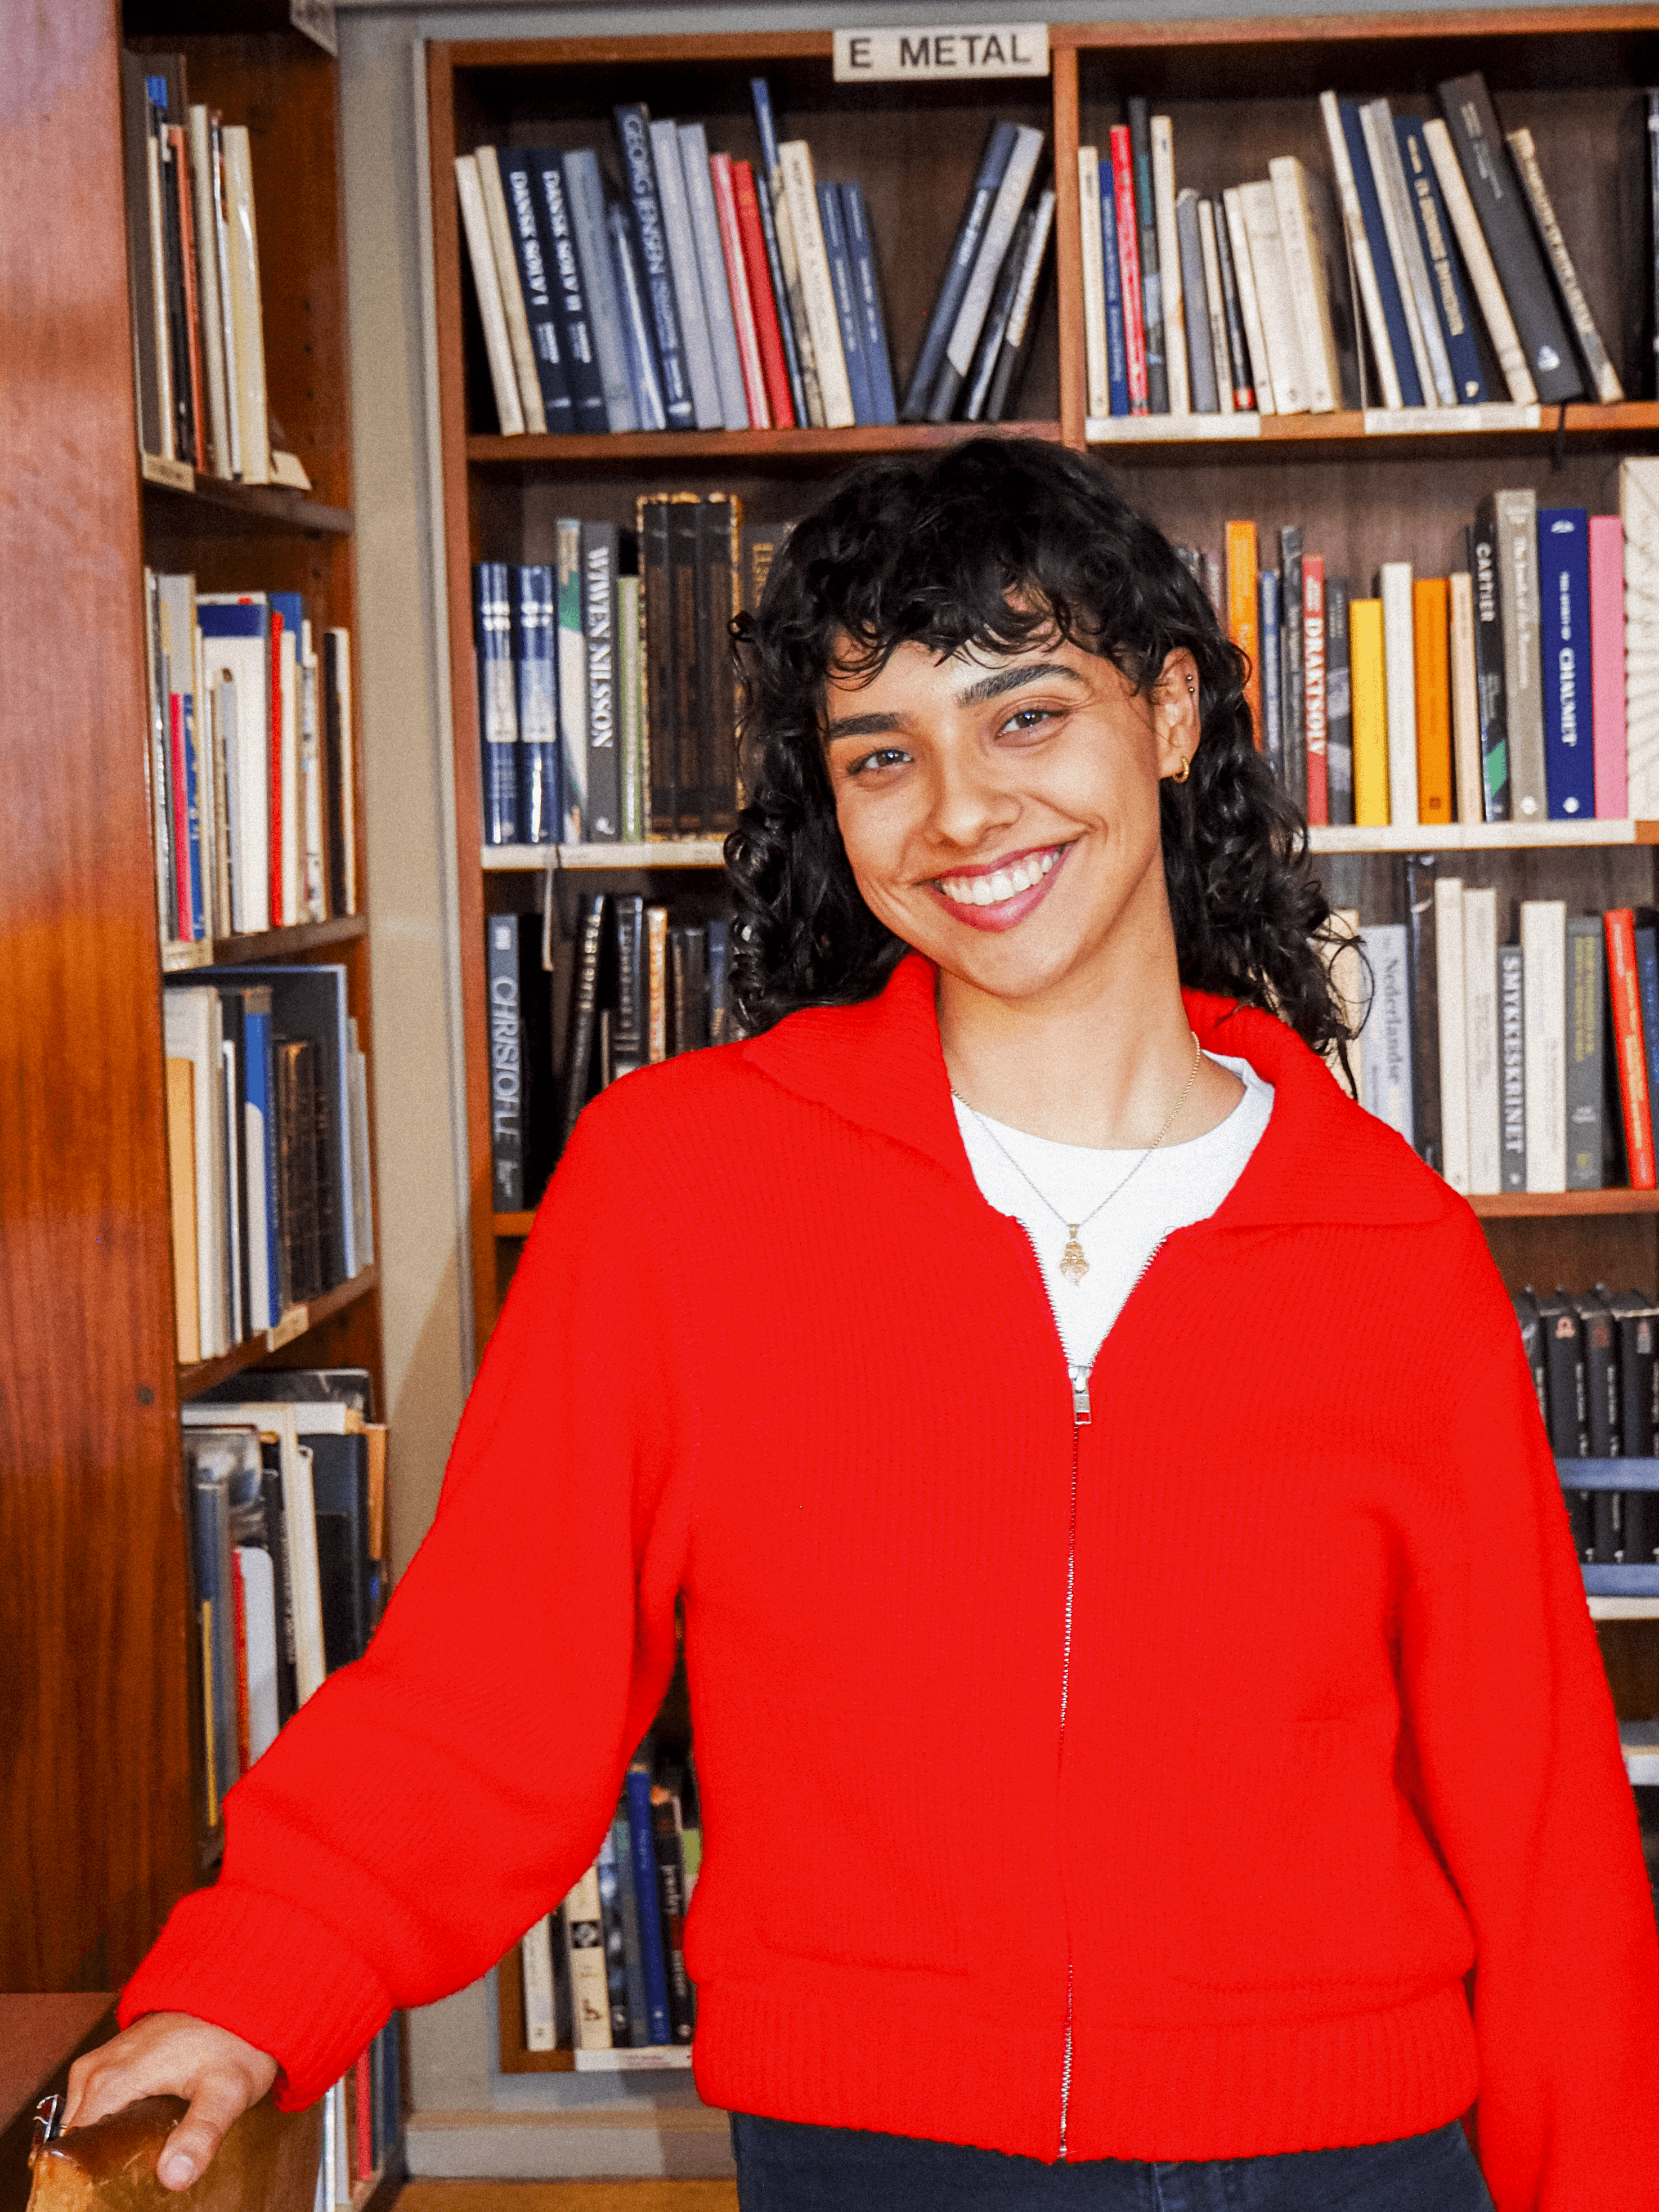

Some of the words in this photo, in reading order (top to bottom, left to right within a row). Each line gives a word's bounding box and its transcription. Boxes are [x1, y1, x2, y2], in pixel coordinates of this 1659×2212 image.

[849, 38, 872, 68] E
[900, 34, 1031, 67] METAL
[624, 114, 653, 195] GEORG
[510, 171, 537, 238] DANSK
[542, 170, 570, 238] DANSK
[632, 197, 666, 275] JENSEN
[588, 547, 612, 638] WIWEN
[1476, 542, 1496, 622] CARTIER
[590, 643, 613, 747] NILSSON
[1558, 647, 1578, 747] CHAUMET
[490, 975, 519, 1143] CHRISTOFLE
[1385, 958, 1402, 1083] Nederlandse
[1502, 956, 1523, 1154] SMYKKESKRINET
